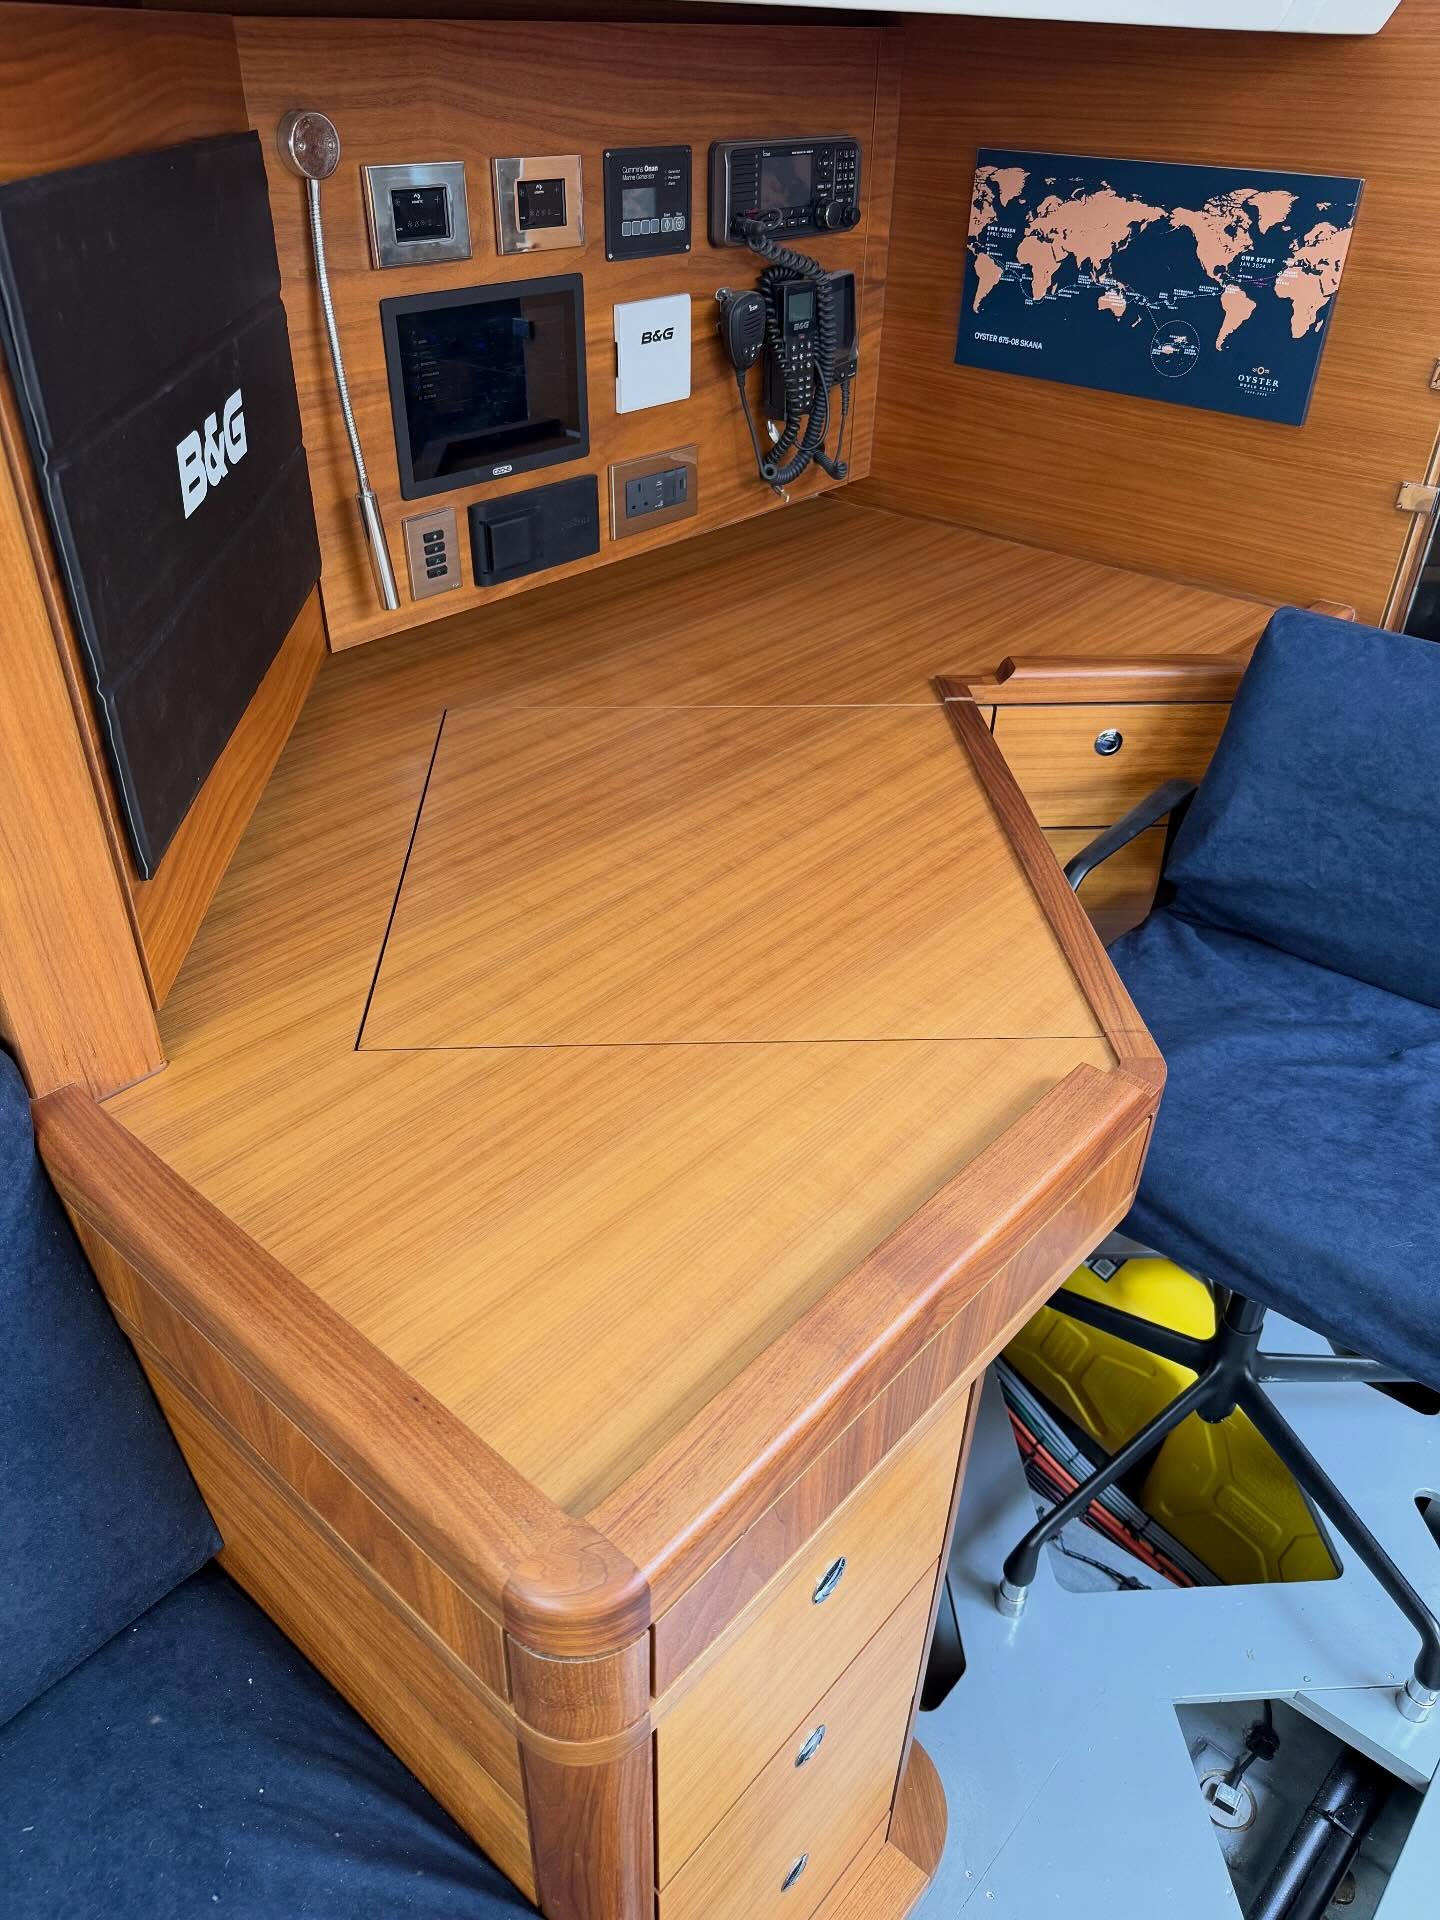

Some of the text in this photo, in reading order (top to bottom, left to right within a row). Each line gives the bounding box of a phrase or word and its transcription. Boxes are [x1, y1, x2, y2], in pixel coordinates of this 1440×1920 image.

[793, 320, 810, 331] B&G
[641, 326, 674, 345] B&G
[974, 331, 1043, 350] OYSTER 675-08 SKANA
[1238, 374, 1279, 388] OYSTER
[176, 387, 249, 520] B&G
